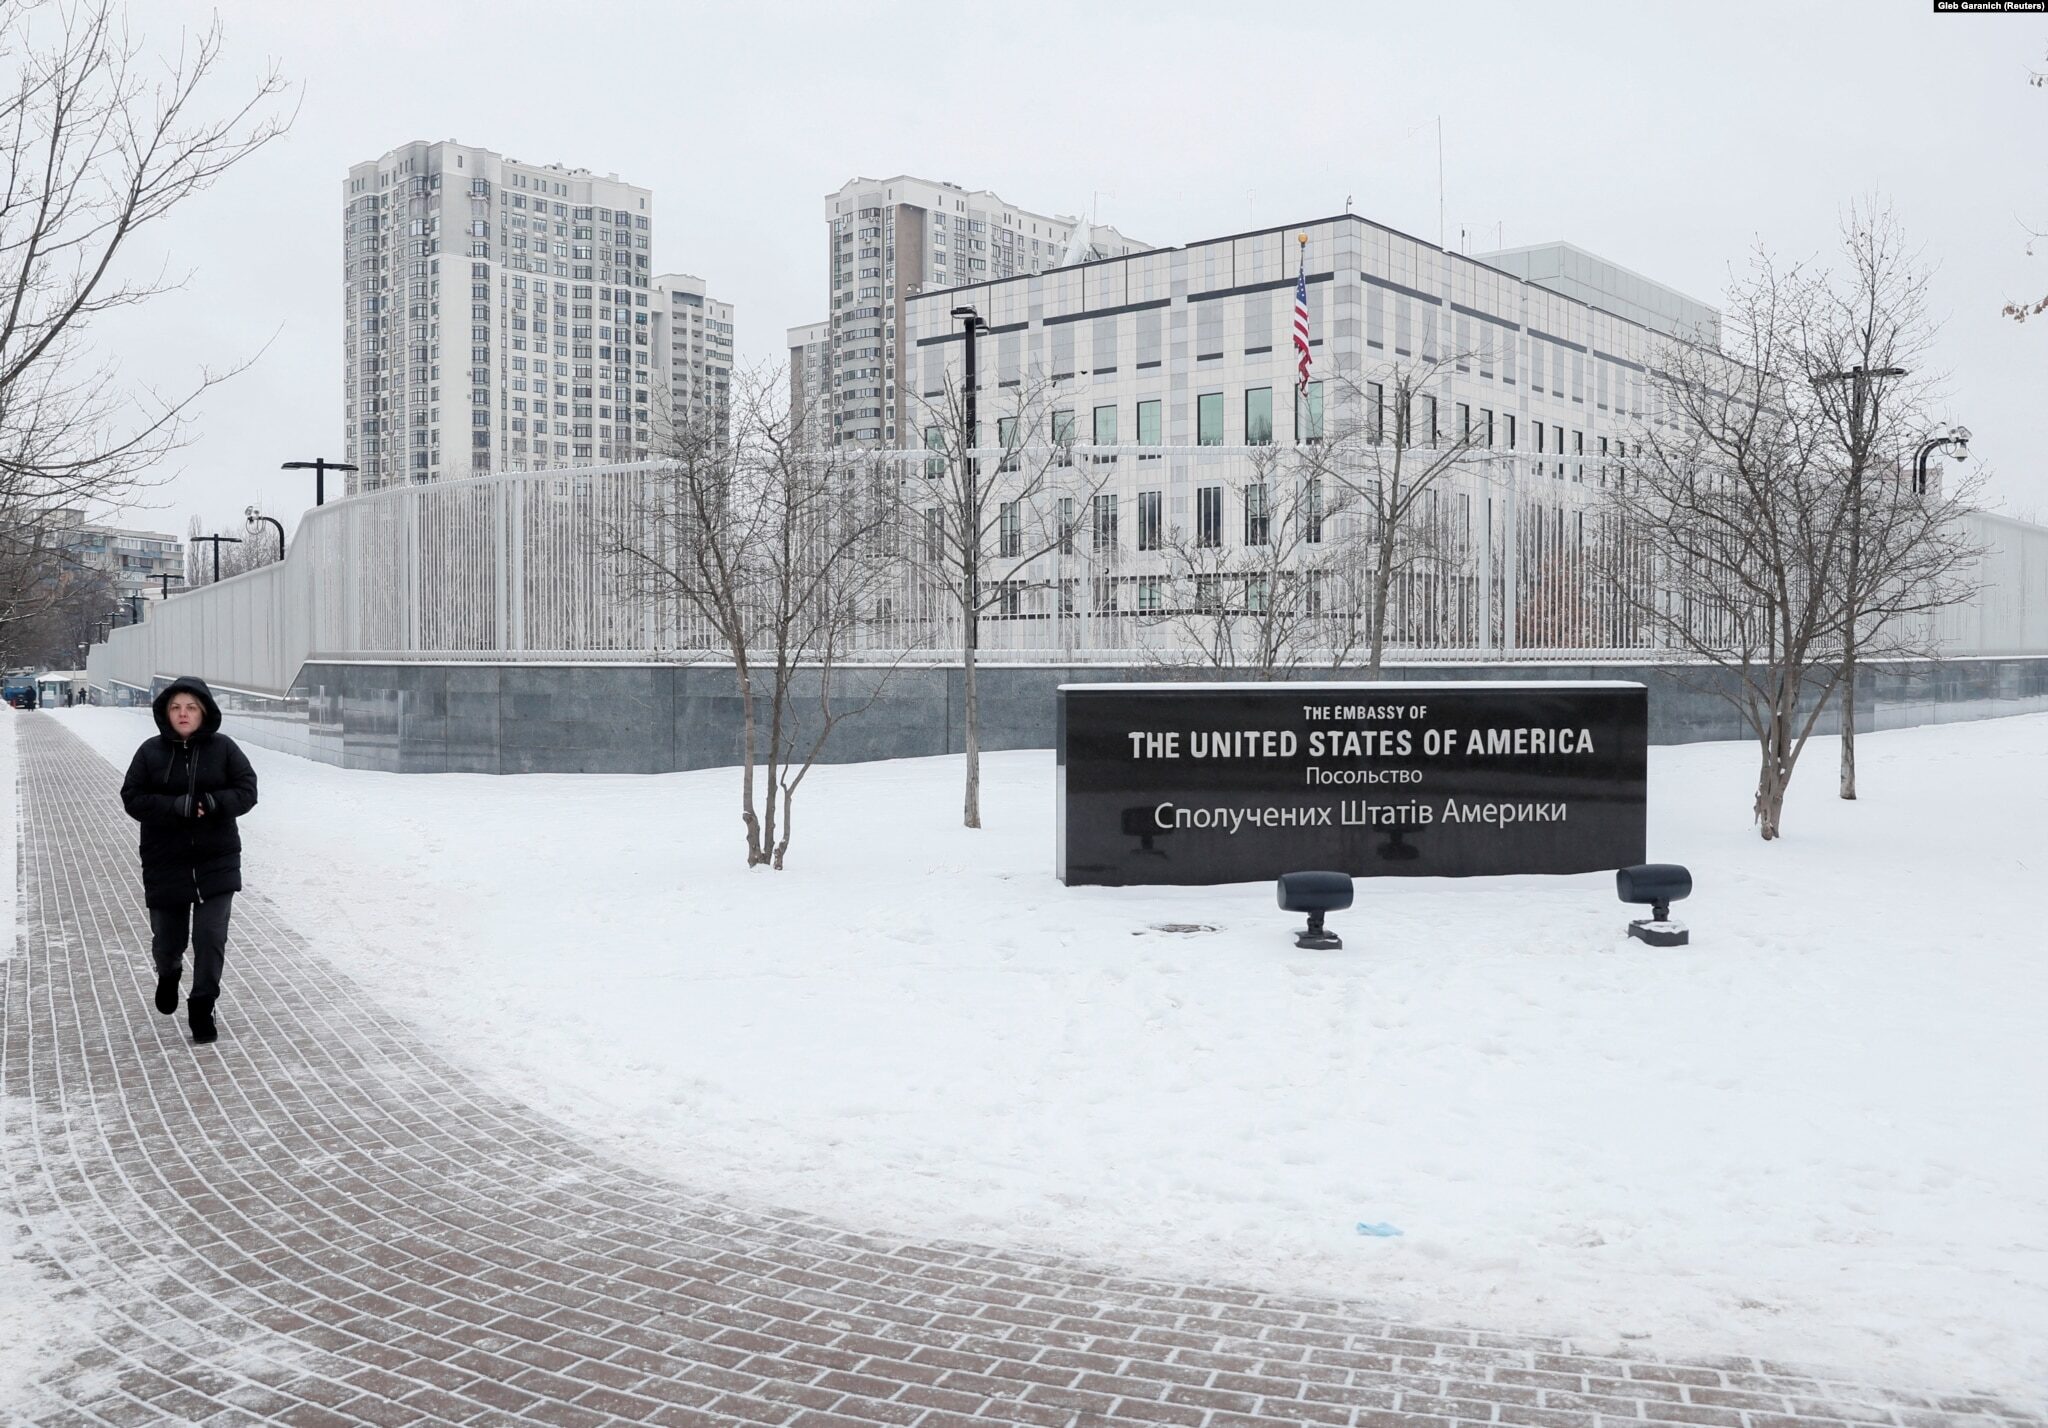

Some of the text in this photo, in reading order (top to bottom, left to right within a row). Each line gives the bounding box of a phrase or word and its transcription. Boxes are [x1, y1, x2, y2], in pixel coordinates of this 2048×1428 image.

[1303, 705, 1427, 720] THE EMBASSY OF
[1128, 728, 1594, 759] THE UNITED STATES OF AMERICA
[1306, 767, 1423, 785] Посольство
[1155, 799, 1567, 835] Сполучених Штатів Америки
